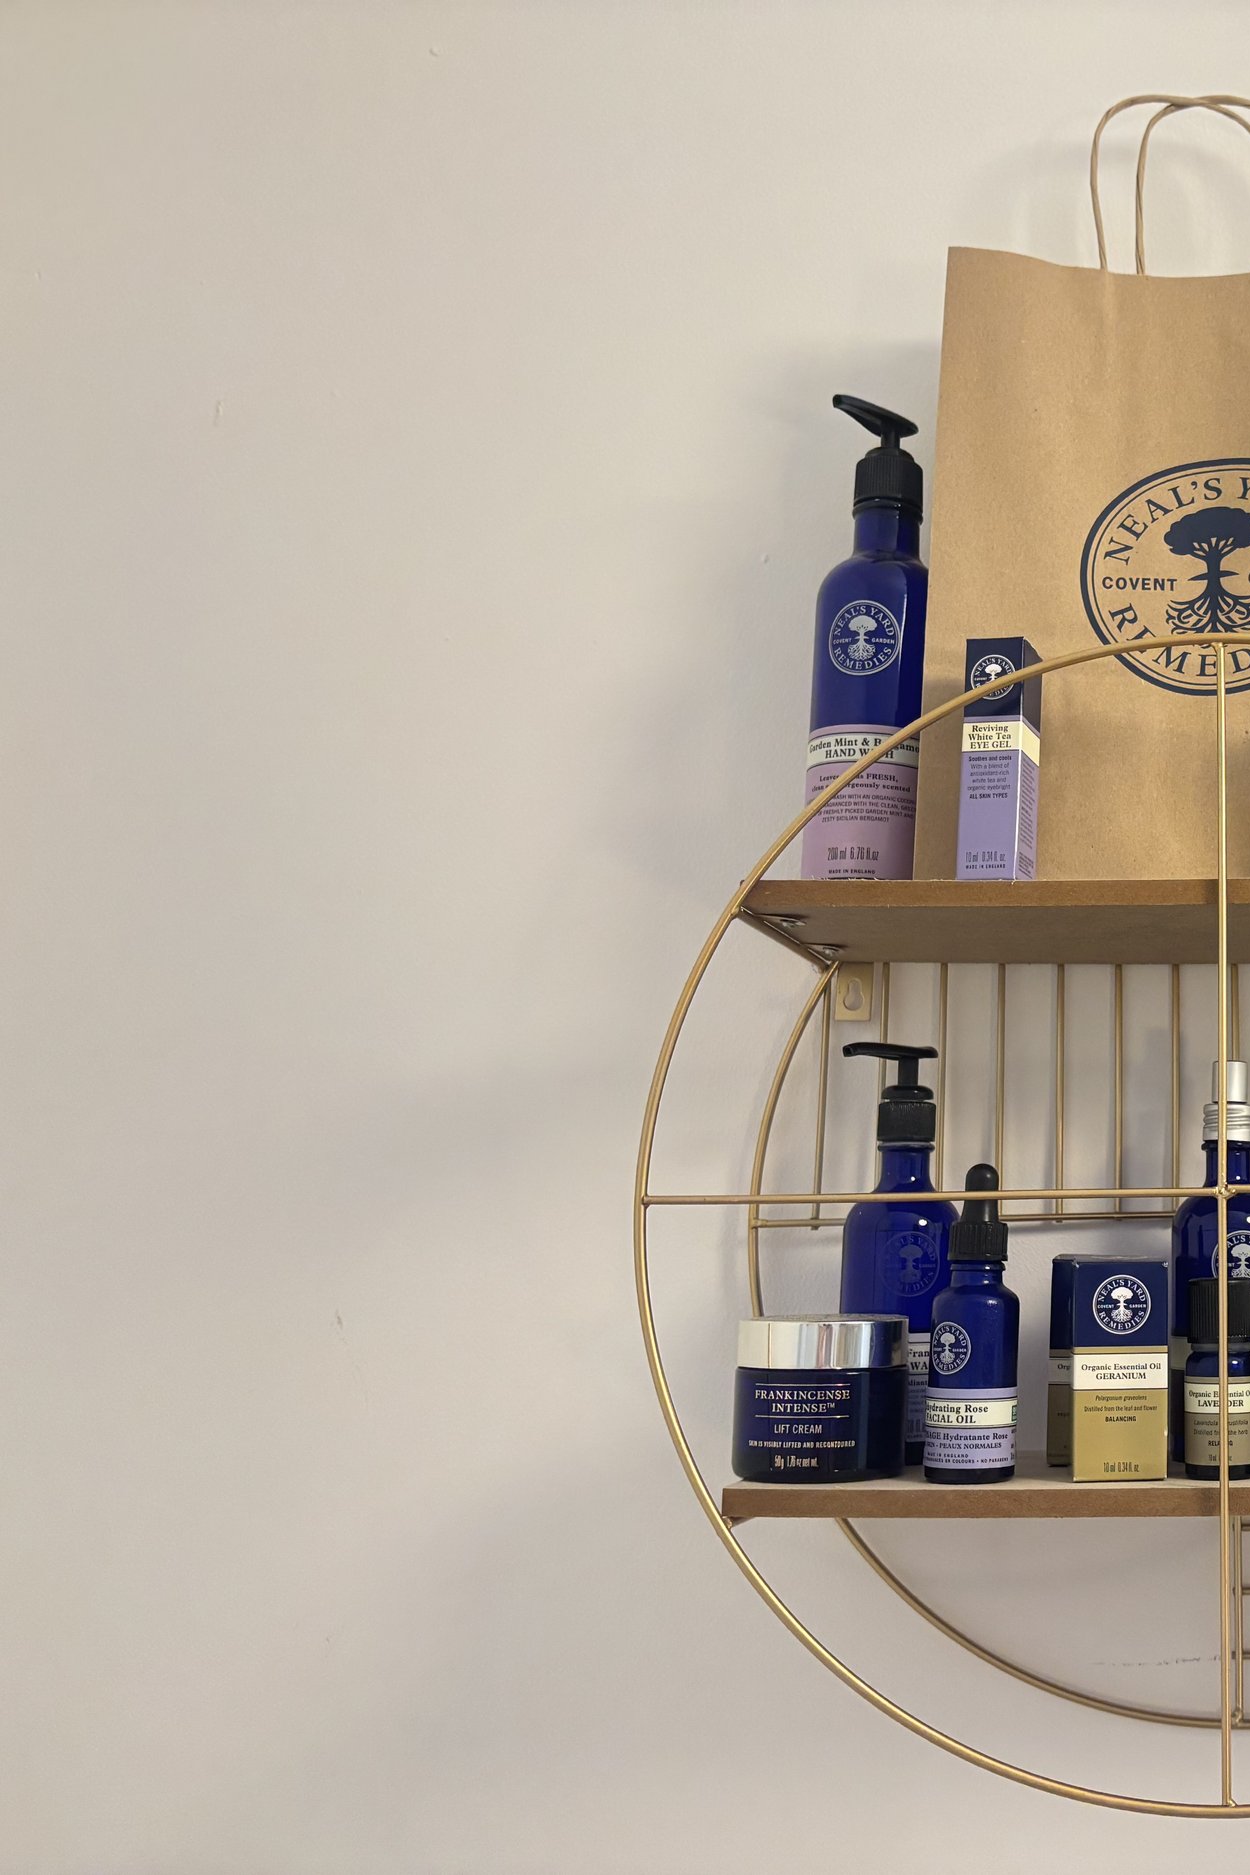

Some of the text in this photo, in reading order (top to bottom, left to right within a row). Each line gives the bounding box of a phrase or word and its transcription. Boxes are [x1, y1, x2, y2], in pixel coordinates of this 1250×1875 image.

[1104, 480, 1222, 565] NEAL'S
[1102, 577, 1177, 591] COVENT
[834, 606, 895, 636] NEAL'S YARD
[834, 647, 891, 669] REMEDIES
[809, 738, 870, 753] Garden Mint &
[825, 748, 856, 758] HAND
[867, 773, 898, 782] FRESH,
[1098, 1280, 1146, 1302] NEAL'S YARD
[1099, 1311, 1145, 1330] REMEDIES
[951, 1326, 966, 1346] YARD
[1096, 1372, 1146, 1380] GERANIUM
[755, 1390, 850, 1400] FRANKINCENSE
[1189, 1390, 1211, 1398] Organic
[965, 1405, 989, 1413] Rose
[926, 1413, 976, 1423] FACIAL OIL
[774, 1424, 822, 1434] LIFT CREAM
[943, 1433, 990, 1441] Hydratante
[816, 1440, 856, 1448] RECONTOURED
